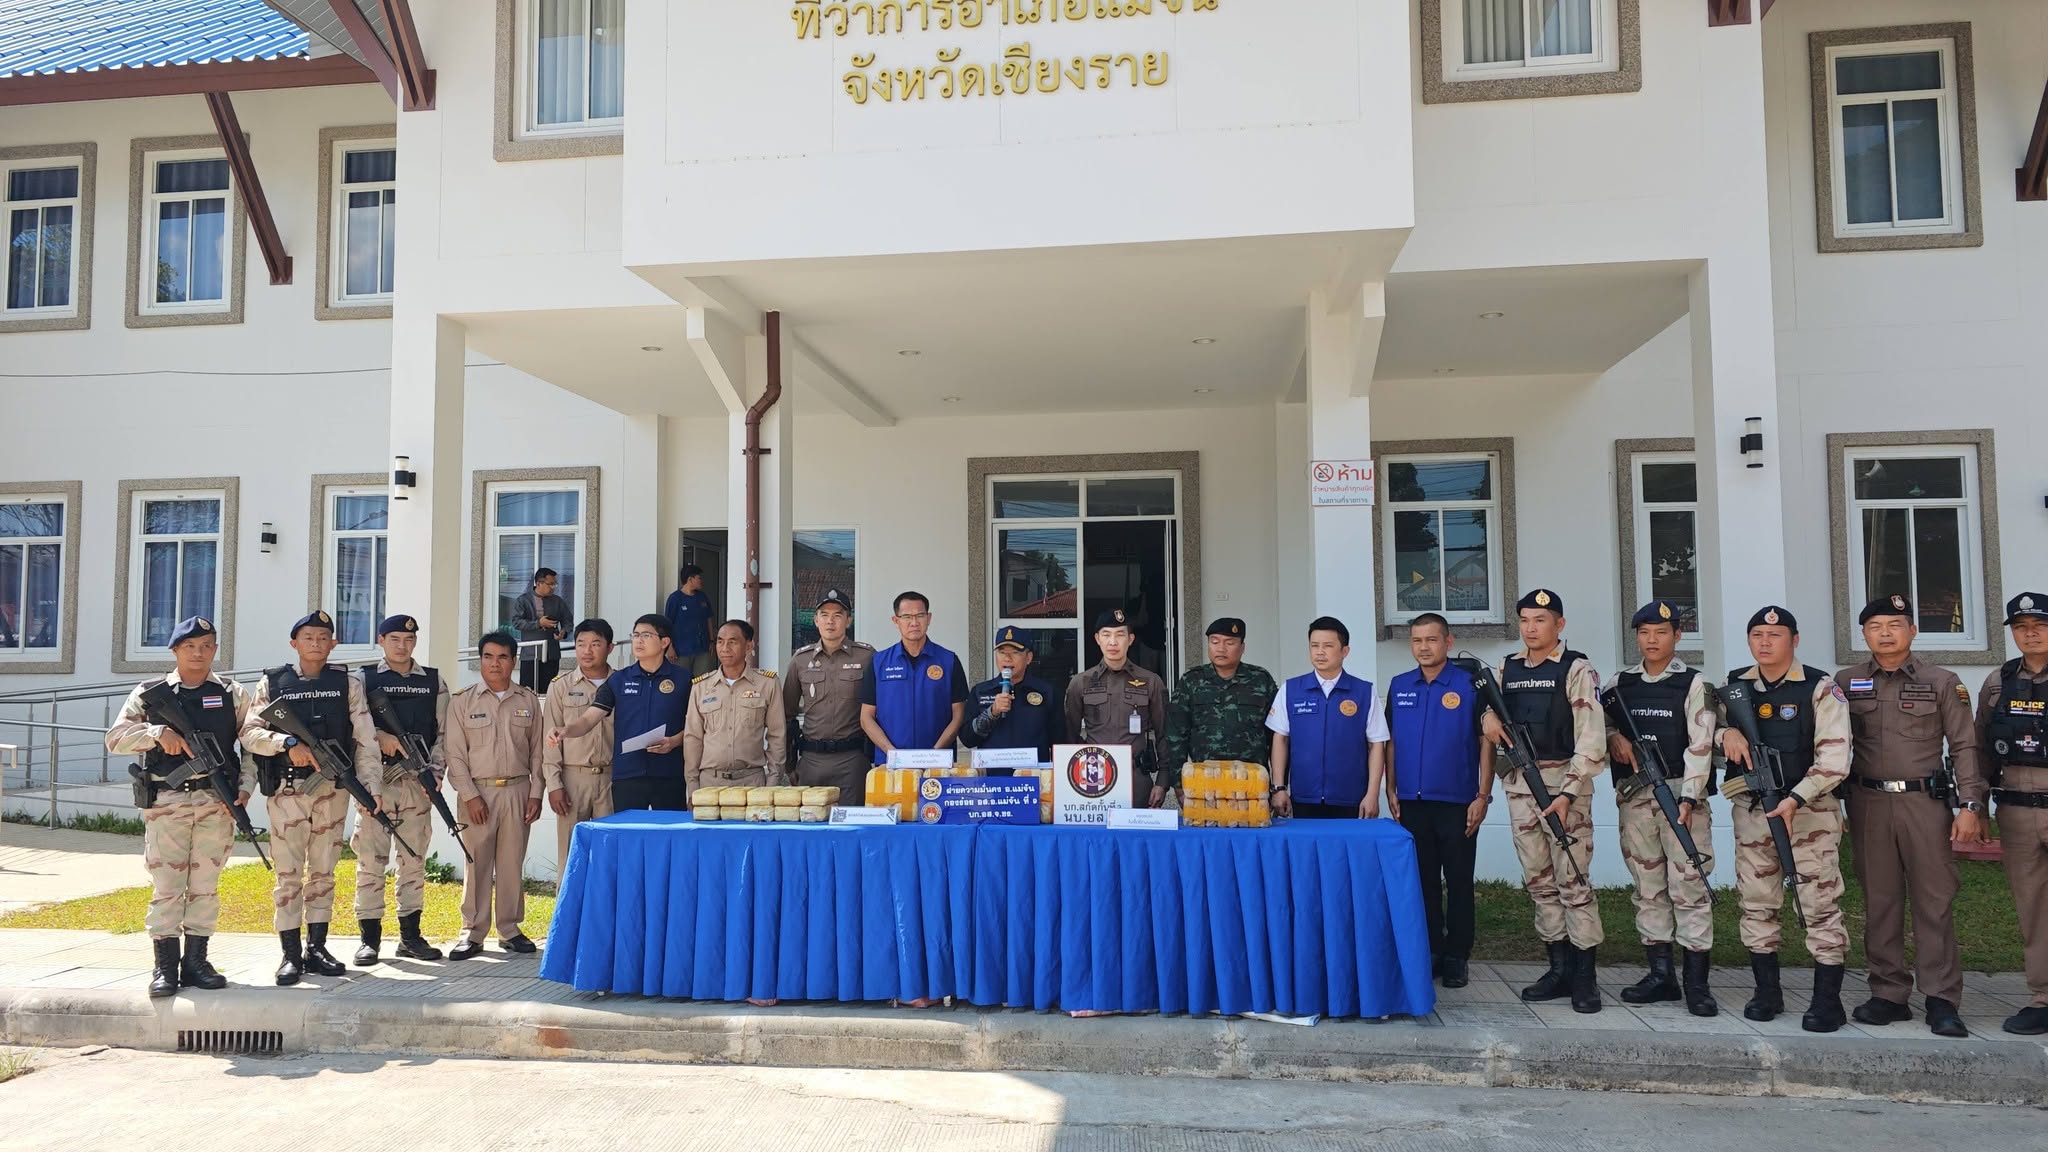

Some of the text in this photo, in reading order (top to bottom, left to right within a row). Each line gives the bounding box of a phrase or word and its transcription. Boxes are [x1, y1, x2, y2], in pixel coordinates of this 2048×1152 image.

[843, 41, 1169, 104] จังหวัดเชียงราย
[1338, 463, 1372, 481] ห้าม
[1507, 678, 1555, 689] กรมการปกครอง
[282, 690, 340, 700] กรมการปกครอง
[2010, 700, 2045, 709] POLICE
[946, 782, 1035, 794] ฝ่ายความมั่นคง อ.แม่จัน
[944, 797, 974, 807] กองร้อย
[977, 796, 1020, 806] อส.อ.แม่จัน
